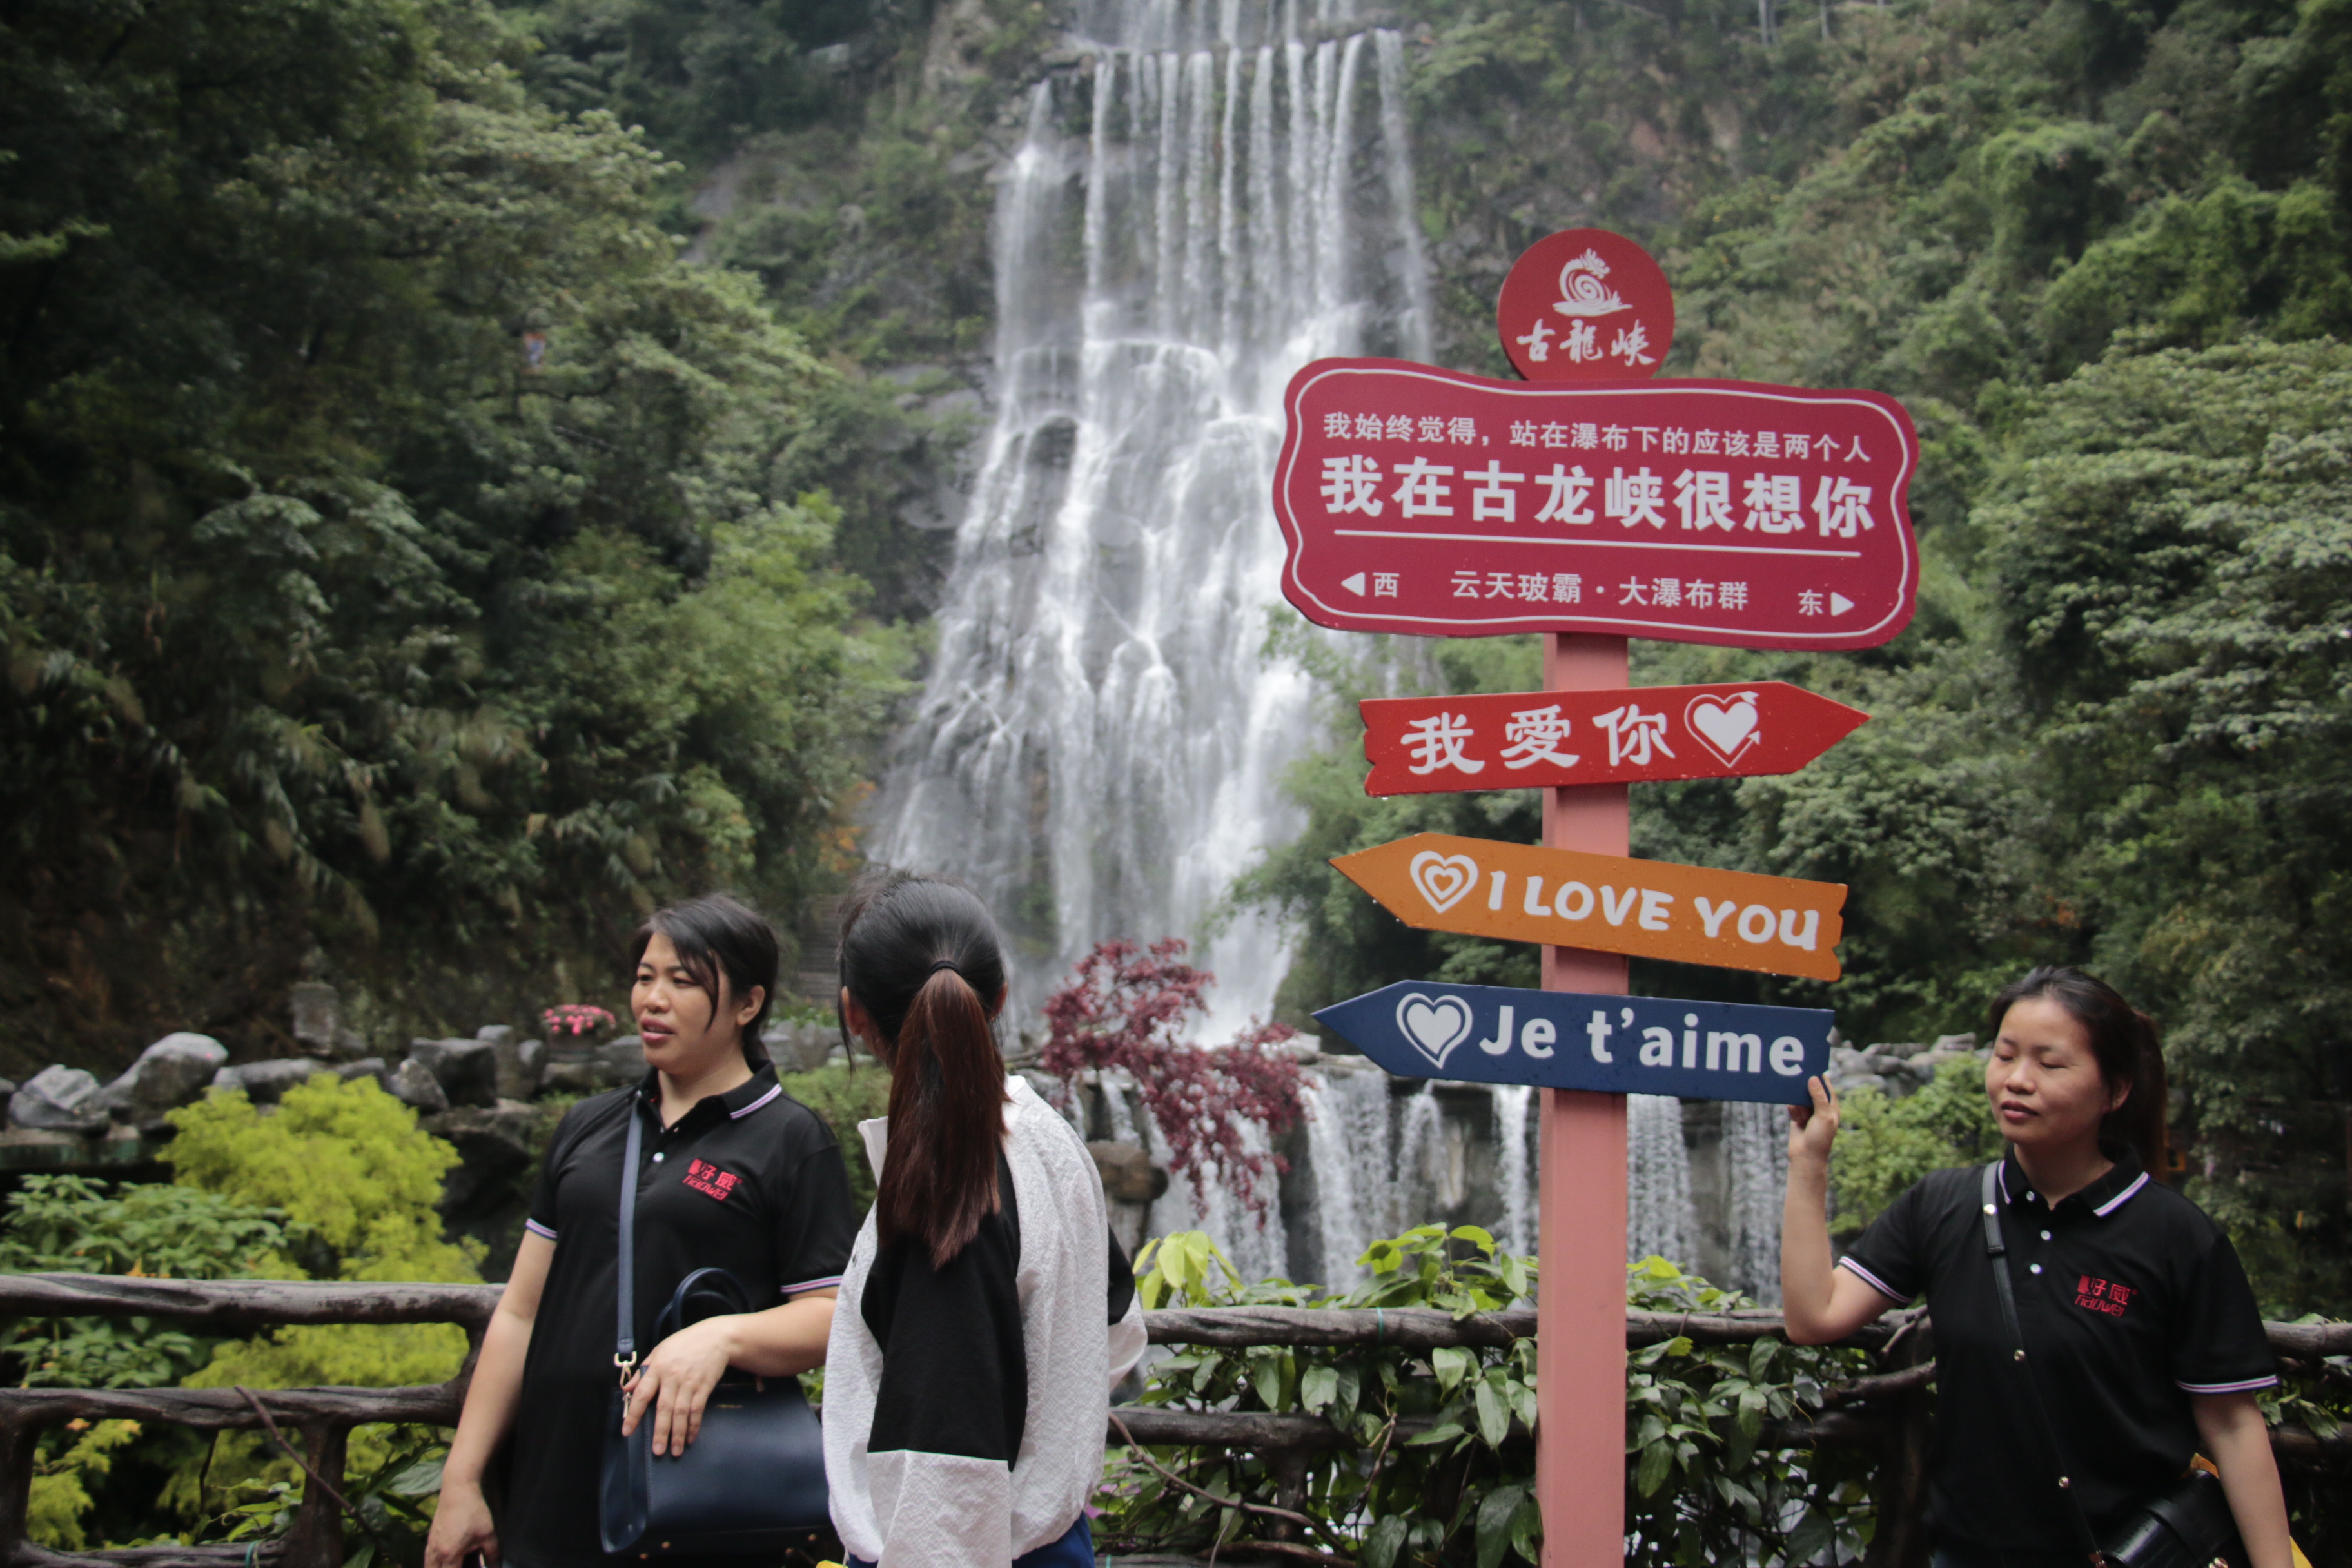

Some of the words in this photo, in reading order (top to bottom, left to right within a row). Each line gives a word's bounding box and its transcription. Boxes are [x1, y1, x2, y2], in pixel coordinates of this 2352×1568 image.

[1319, 453, 1875, 539] 我在古龙峡很想你
[1372, 571, 1400, 598] 西
[1797, 588, 1823, 616] 东
[1487, 870, 1508, 912] I
[1522, 874, 1676, 932] LOVE
[1693, 896, 1821, 952] YOU
[1478, 1004, 1557, 1059] Je
